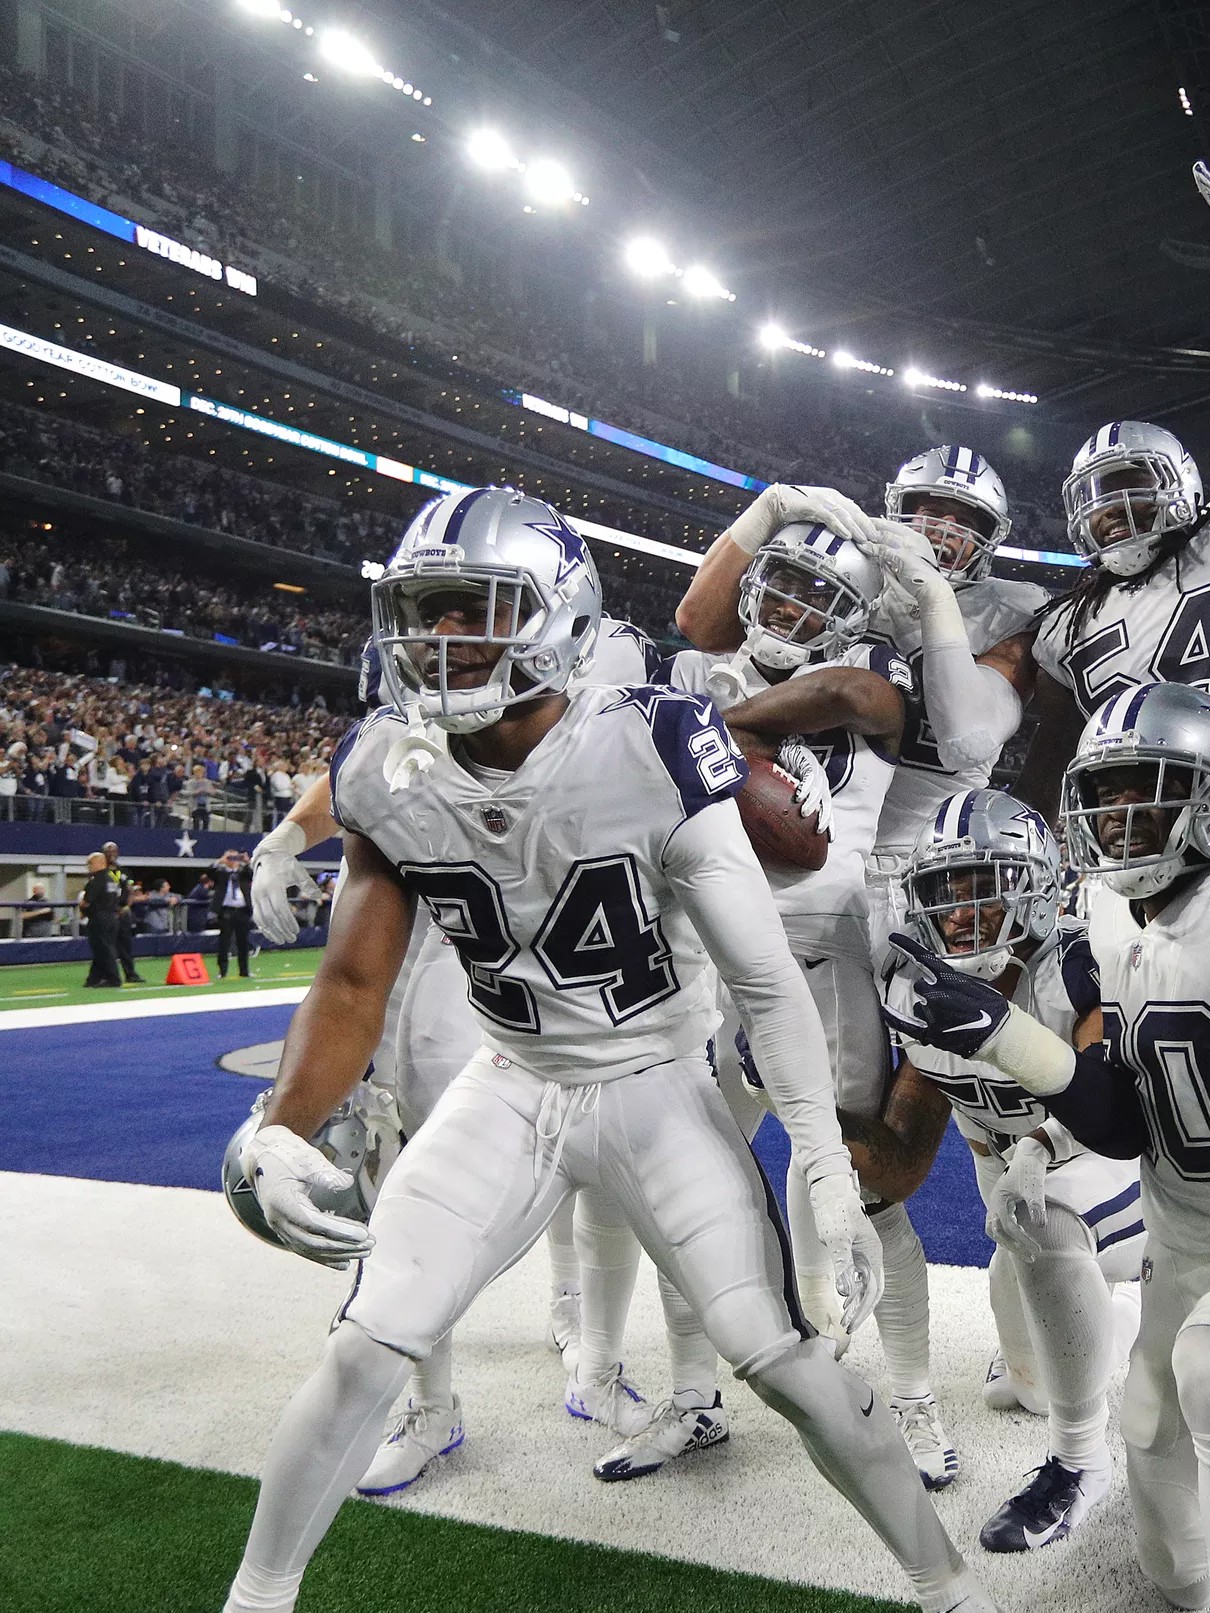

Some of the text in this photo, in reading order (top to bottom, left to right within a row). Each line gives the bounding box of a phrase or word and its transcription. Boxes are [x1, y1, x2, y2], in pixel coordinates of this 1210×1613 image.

[411, 549, 447, 558] COWBOYS
[397, 853, 681, 1028] 24
[182, 958, 202, 979] G
